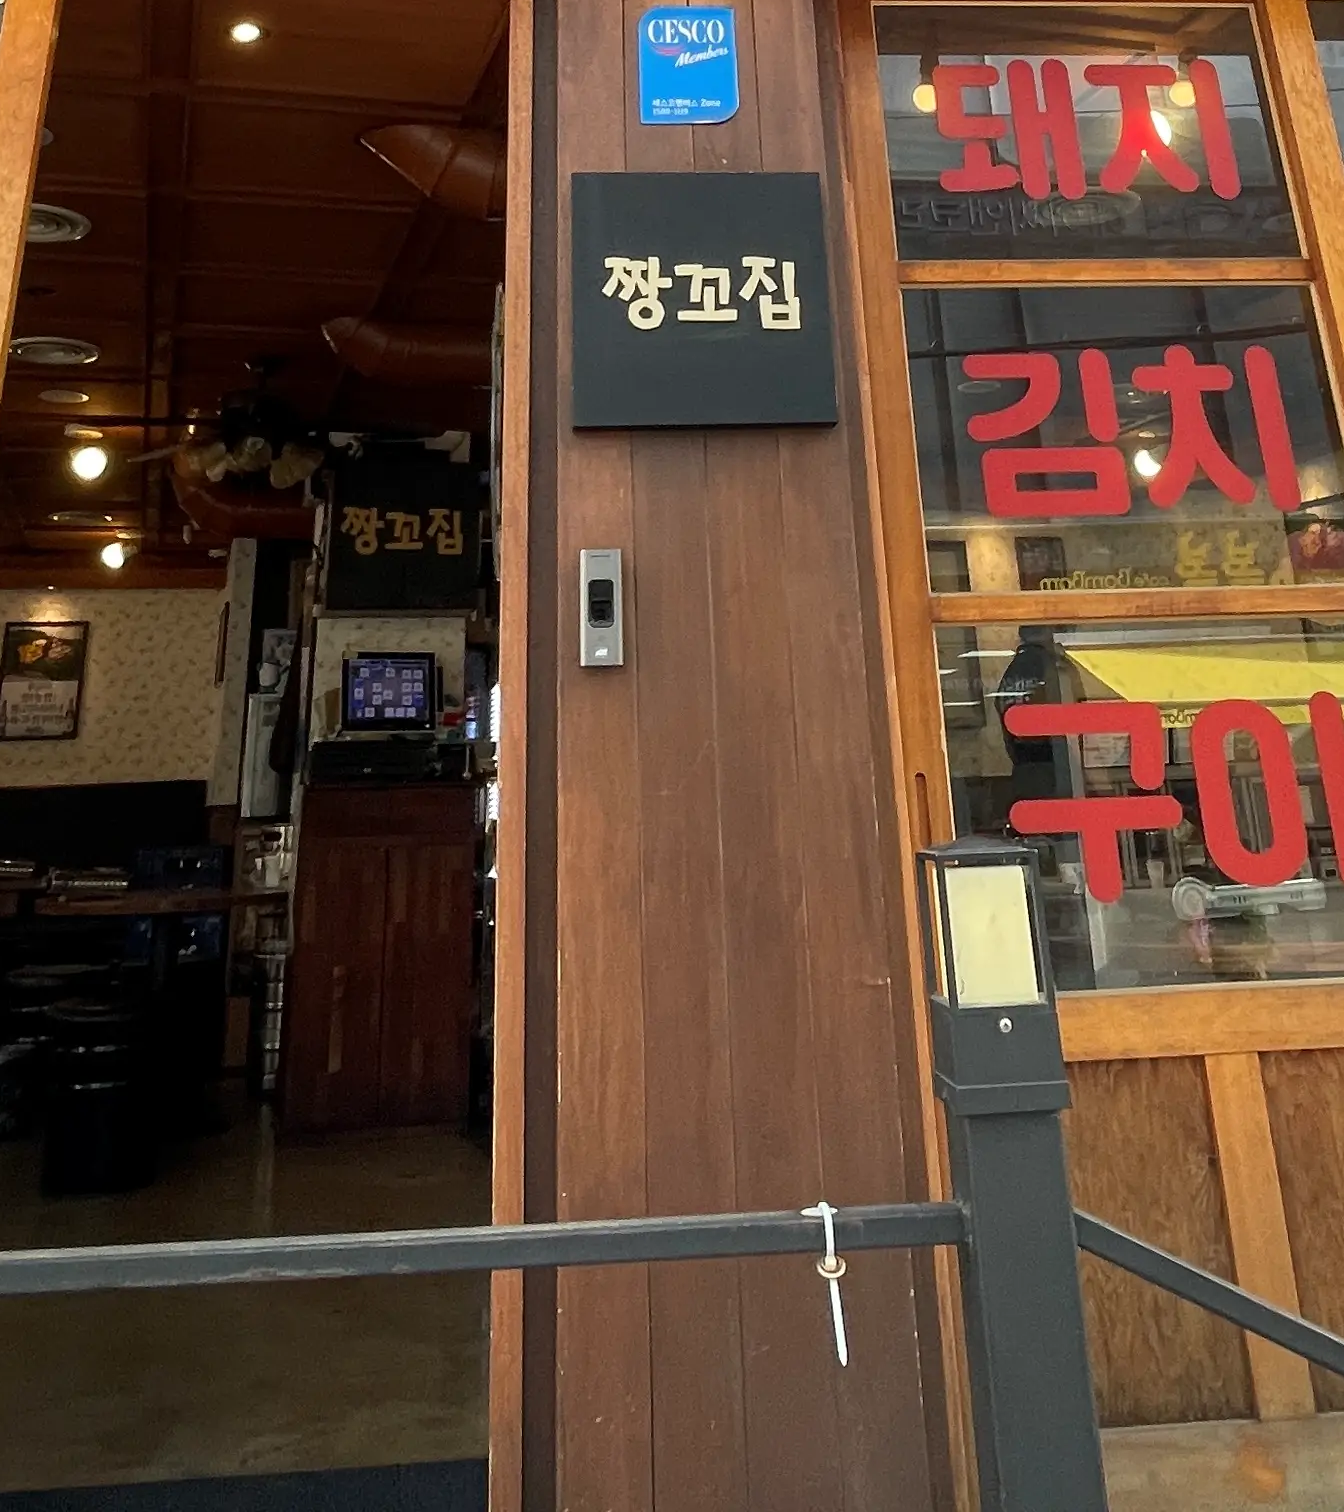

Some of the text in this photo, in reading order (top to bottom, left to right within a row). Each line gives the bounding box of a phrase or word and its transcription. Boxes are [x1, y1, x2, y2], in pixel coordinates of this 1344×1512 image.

[647, 19, 725, 44] CESCO
[674, 44, 730, 68] Members
[931, 58, 1243, 201] 돼지
[601, 256, 802, 330] 짱꼬집
[961, 343, 1302, 517] 김치
[340, 506, 464, 556] 짱꼬집
